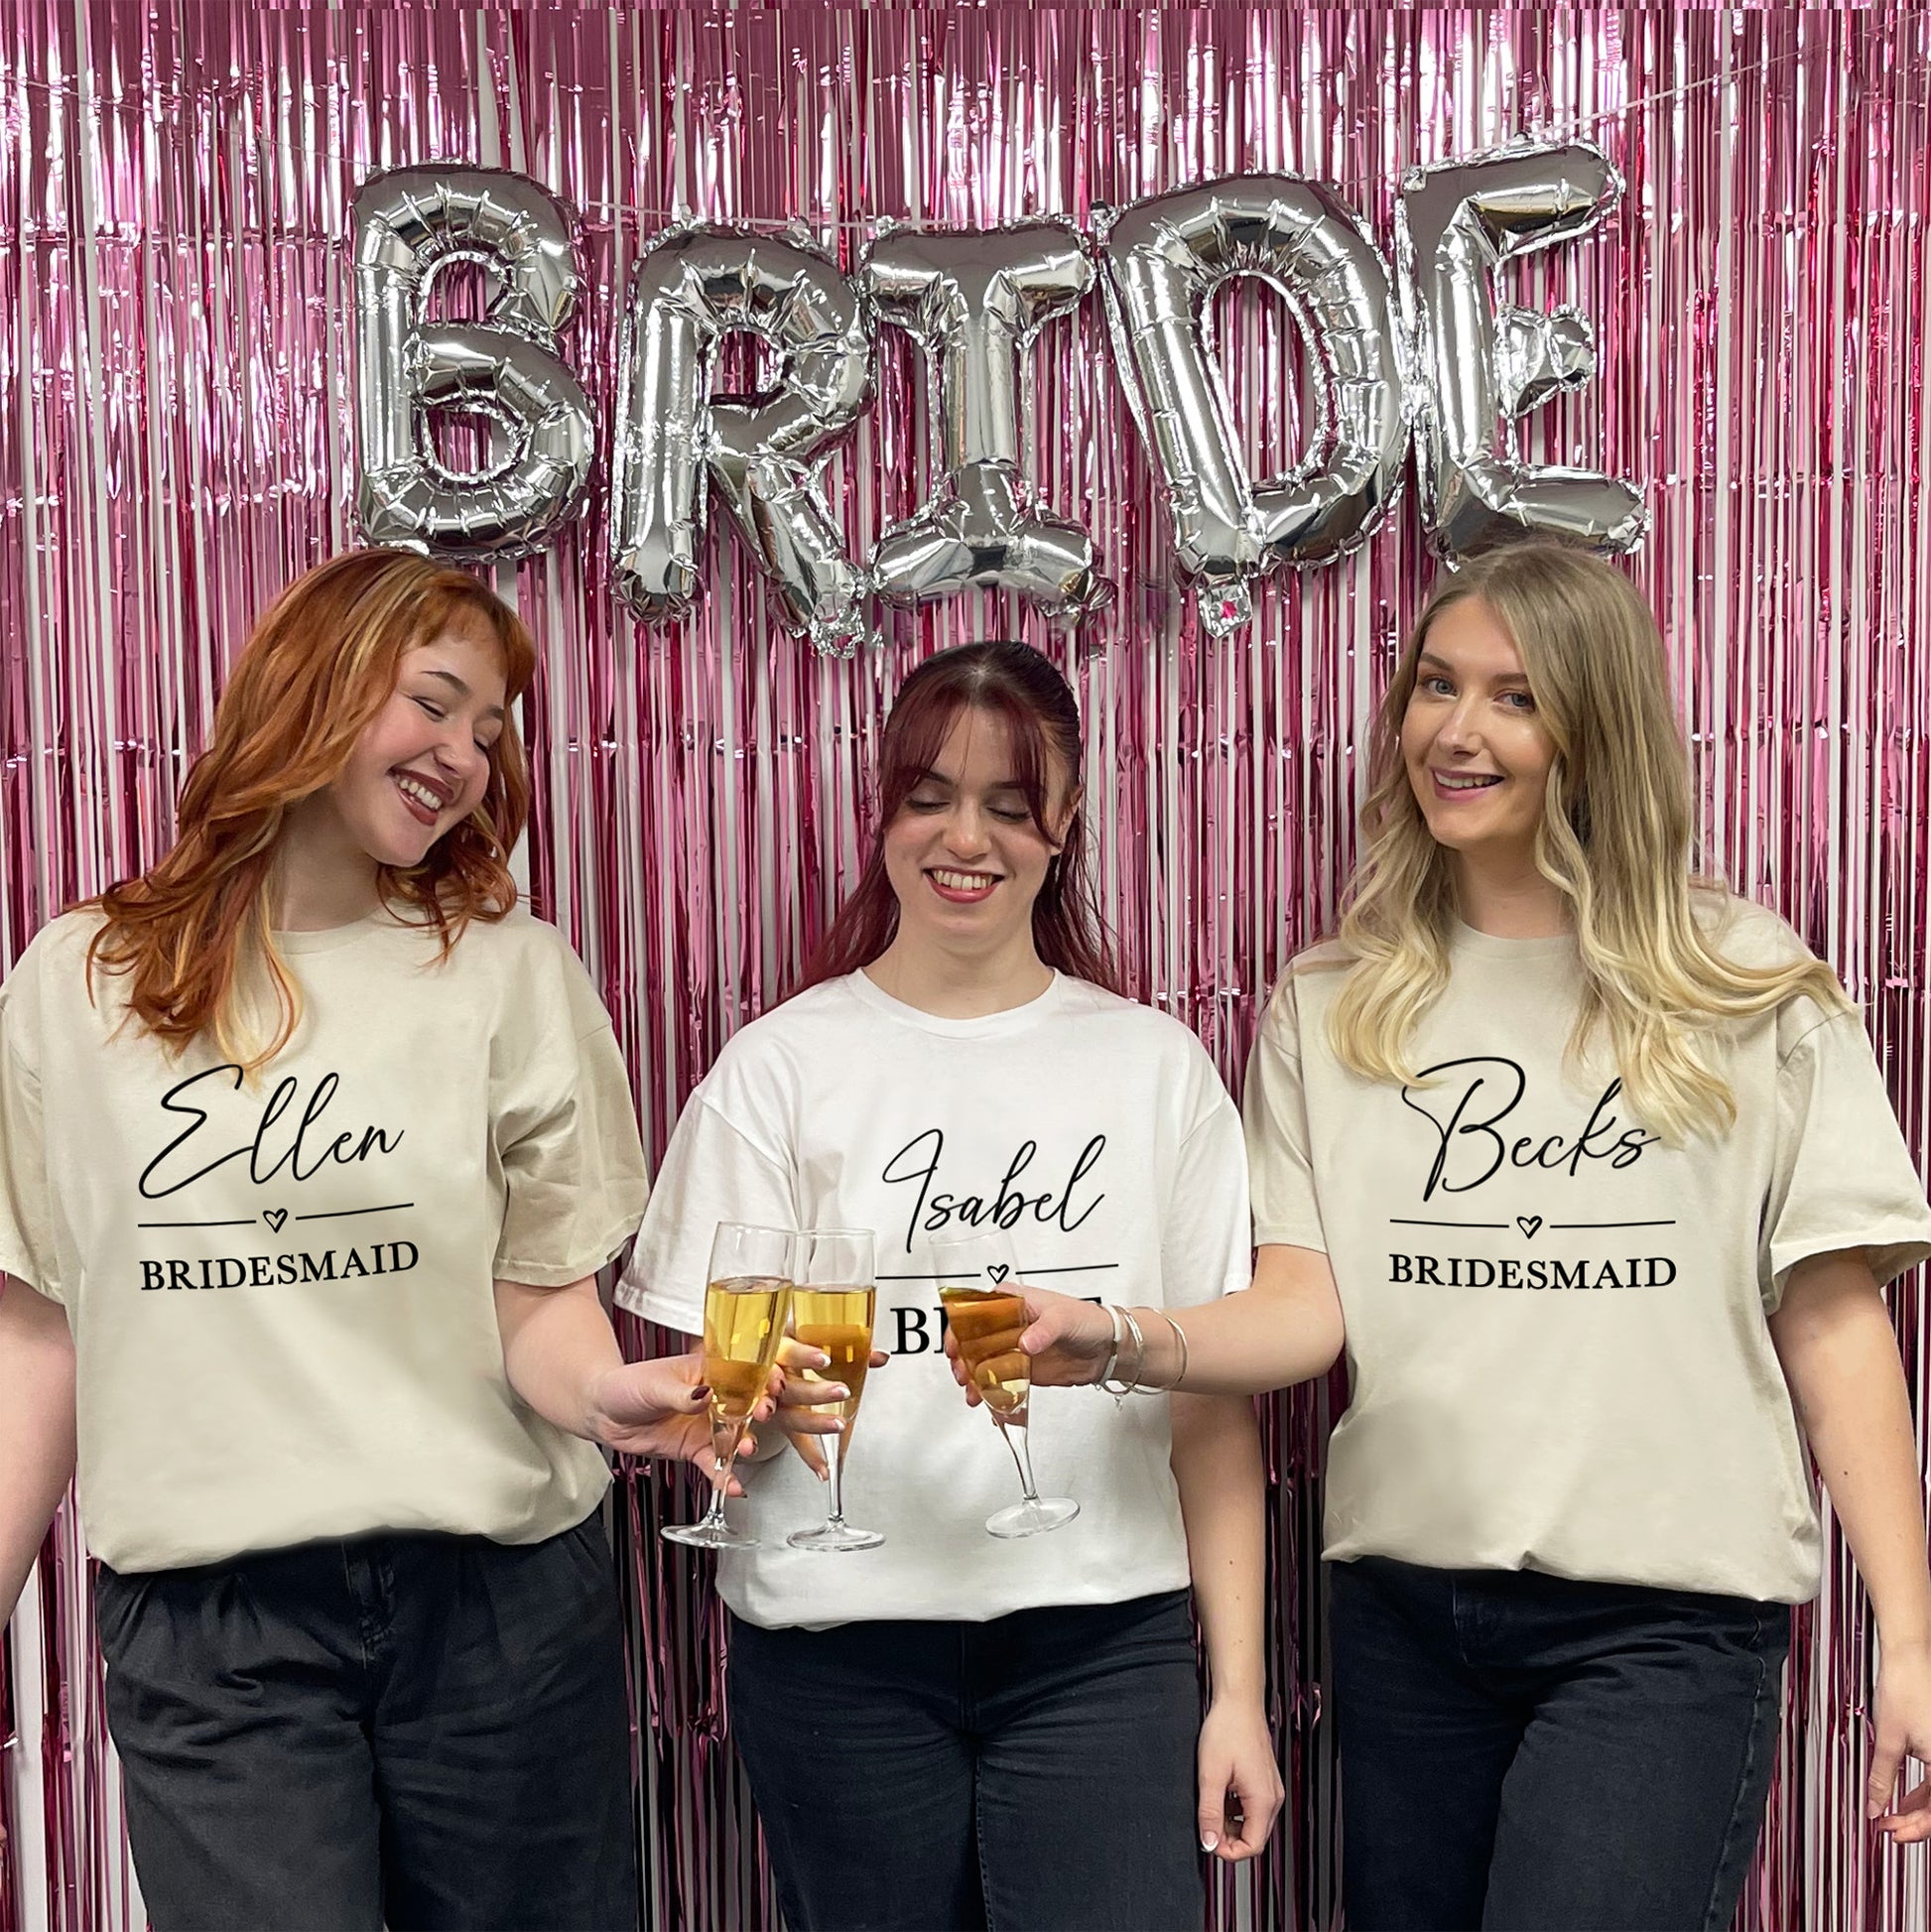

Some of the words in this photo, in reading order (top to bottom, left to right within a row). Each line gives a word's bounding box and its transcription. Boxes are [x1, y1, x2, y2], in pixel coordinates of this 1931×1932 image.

[349, 138, 1650, 657] BRIDE
[138, 1063, 405, 1200] Ellen
[881, 1127, 1107, 1254] Isabel
[1400, 1056, 1662, 1203] Becks
[139, 1240, 420, 1291] BRIDESMAID
[1388, 1252, 1677, 1290] BRIDESMAID
